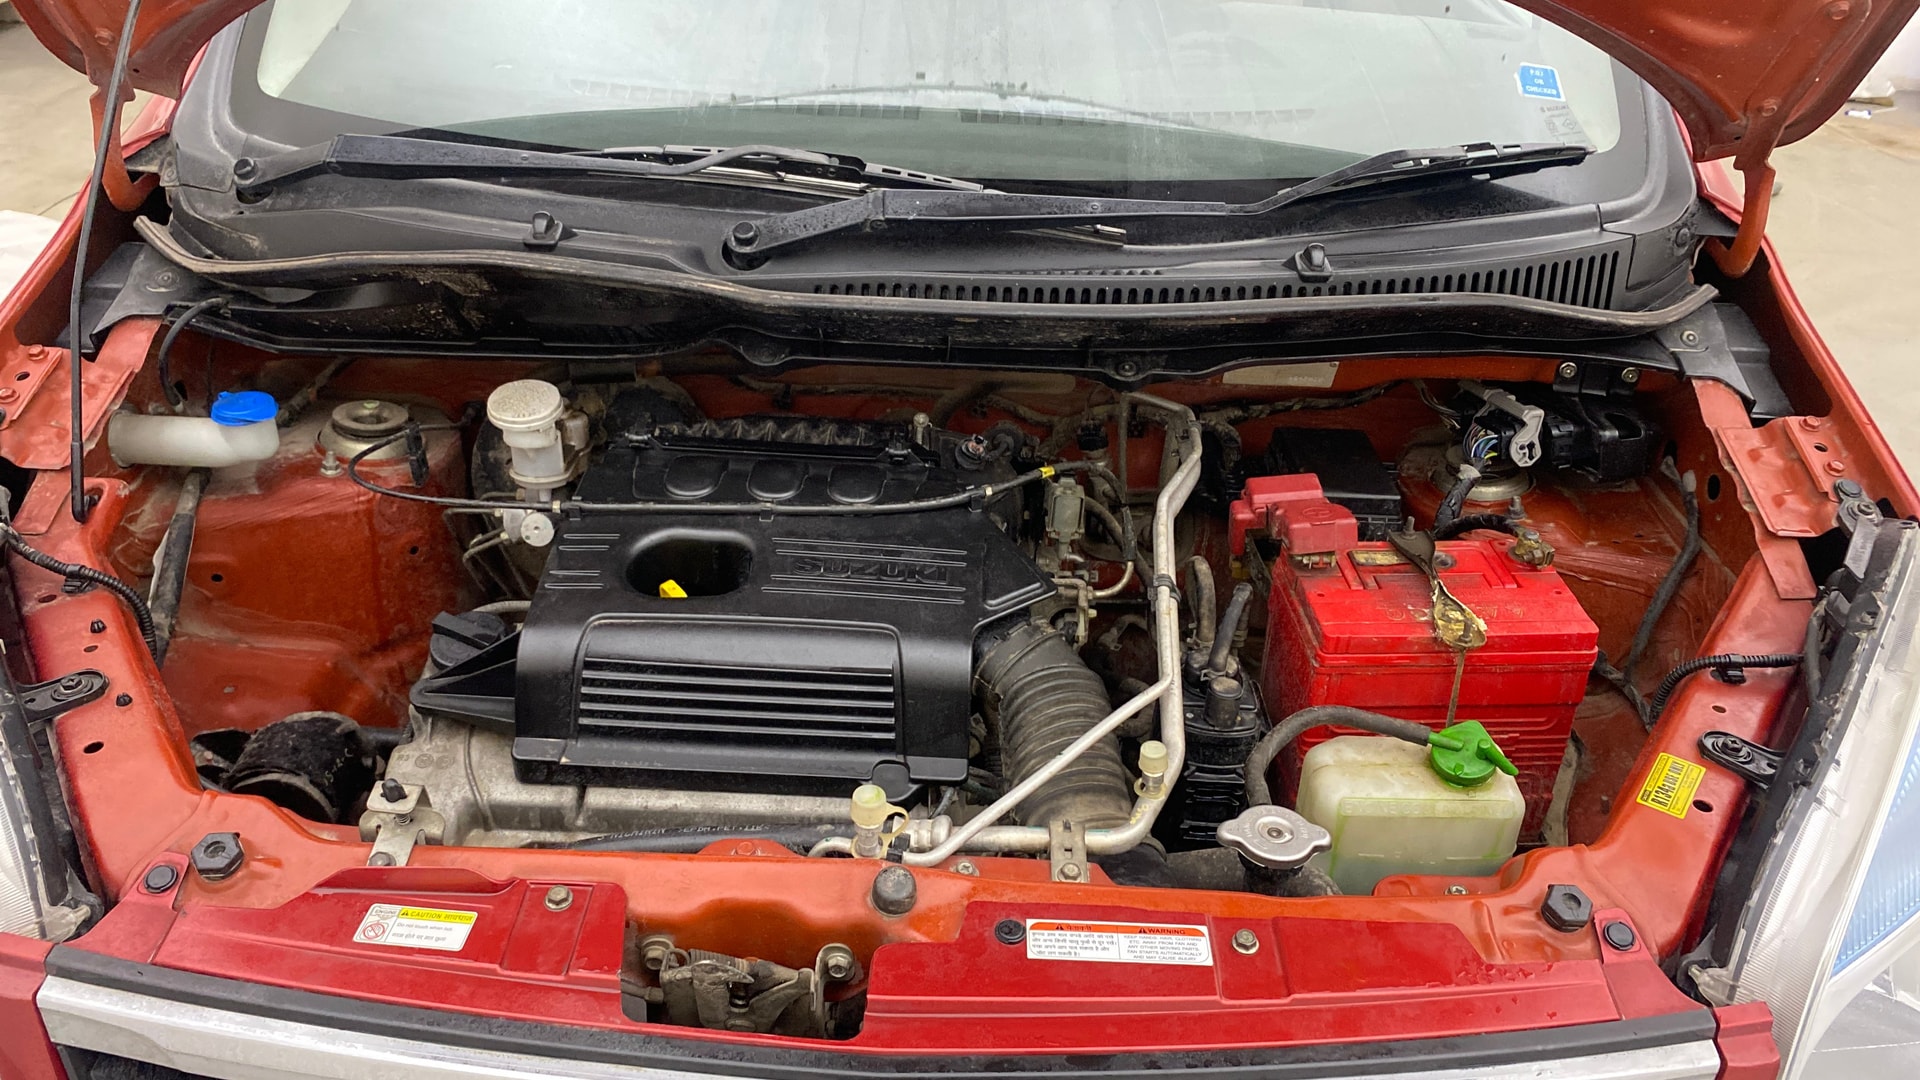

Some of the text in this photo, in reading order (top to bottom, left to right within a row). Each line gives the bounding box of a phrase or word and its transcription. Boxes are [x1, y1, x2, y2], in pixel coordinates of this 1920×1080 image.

[793, 557, 947, 584] SUZUKI
[411, 911, 443, 919] CAUTION
[1147, 927, 1186, 935] WARNING
